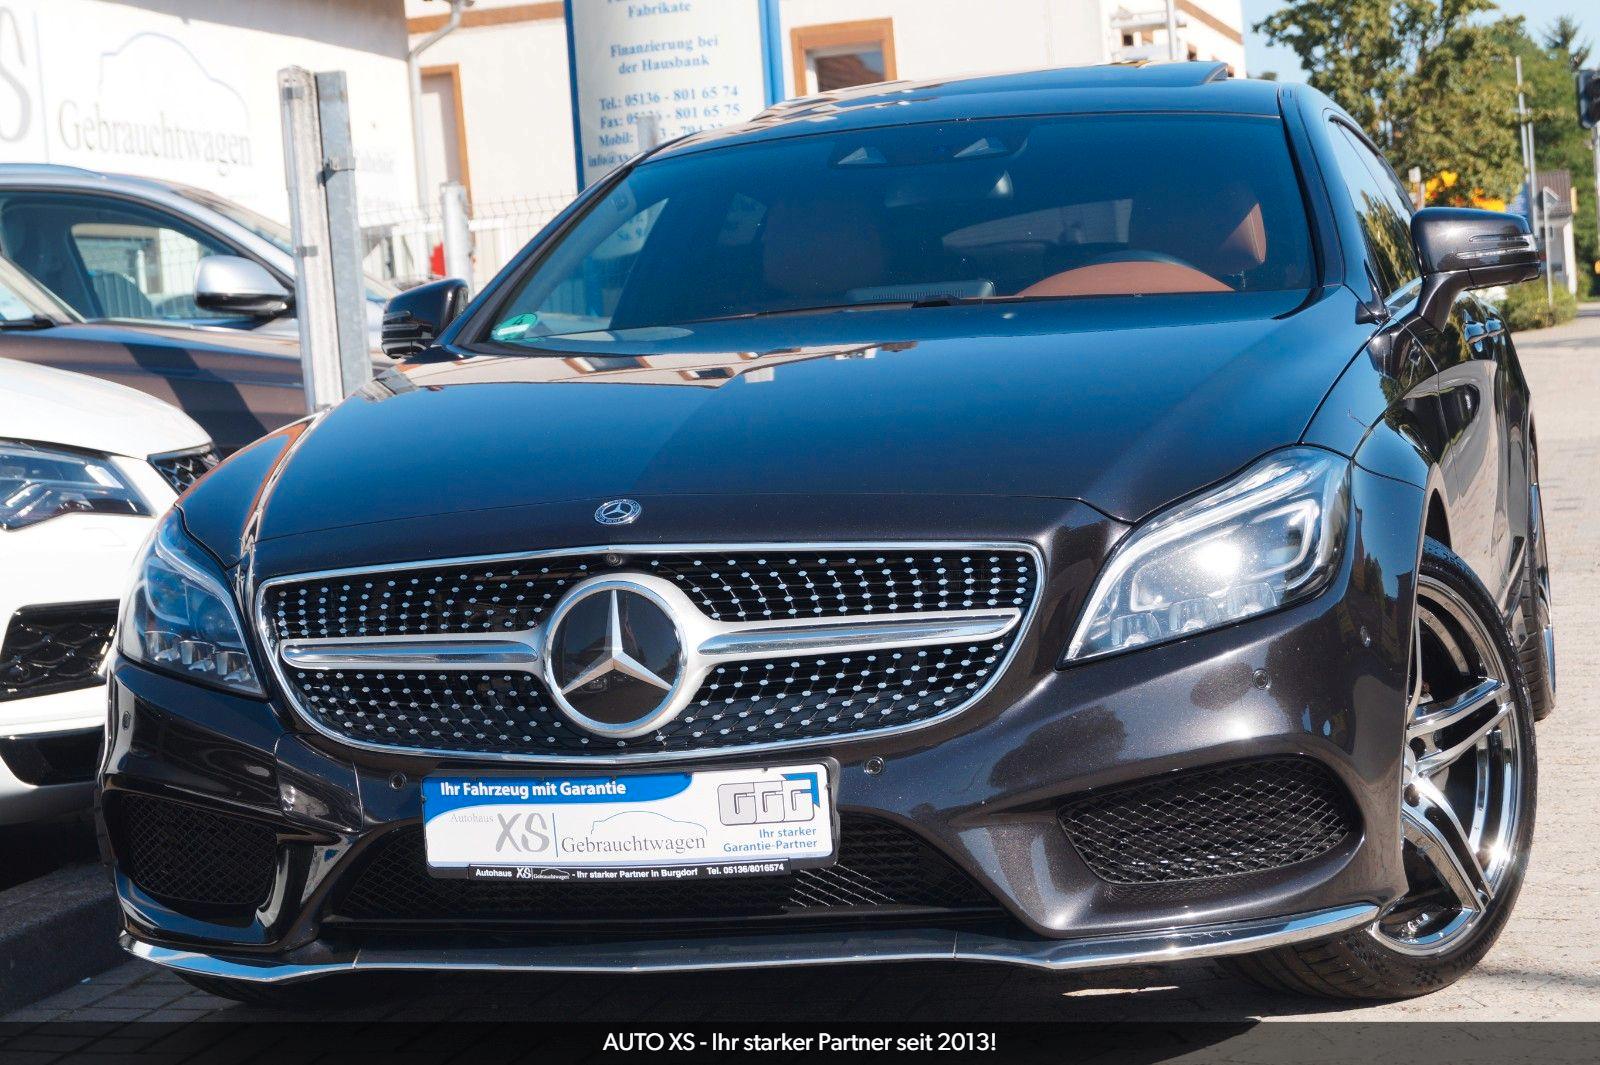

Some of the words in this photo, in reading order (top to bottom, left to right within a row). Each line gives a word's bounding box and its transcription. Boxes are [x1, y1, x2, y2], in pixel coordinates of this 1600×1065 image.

[628, 2, 691, 18] Fabrikate
[610, 39, 693, 57] Finanzierung
[698, 35, 718, 47] bei
[618, 62, 637, 75] der
[642, 54, 709, 71] Hausbank
[624, 91, 660, 106] 05136
[673, 88, 695, 100] 801
[702, 86, 717, 98] 65
[722, 85, 738, 96] 74
[600, 116, 622, 129] Fax:
[675, 107, 696, 119] 801
[704, 105, 719, 117] 65
[725, 104, 740, 116] 75
[58, 98, 253, 177] Gebrauchtwagen
[600, 132, 633, 146] Mobil:
[440, 782, 460, 796] Ihr
[463, 782, 529, 799] Fahrzeug
[532, 782, 558, 796] mit
[560, 780, 627, 796] Garantie
[450, 813, 495, 823] Autohaus
[495, 812, 550, 853] XS
[561, 835, 706, 854] Gebrauchtwagen
[759, 828, 775, 839] Ihr
[779, 826, 817, 838] starker
[723, 840, 817, 852] Garantie-Partner
[475, 868, 513, 878] Autohaus
[516, 867, 532, 879] XS
[577, 870, 588, 879] Ihr
[590, 870, 619, 879] starker
[620, 870, 650, 878] Partner
[651, 869, 659, 878] in
[661, 868, 698, 879] Burgdorf
[707, 867, 722, 876] Tel.
[723, 863, 785, 875] 05136/8016574
